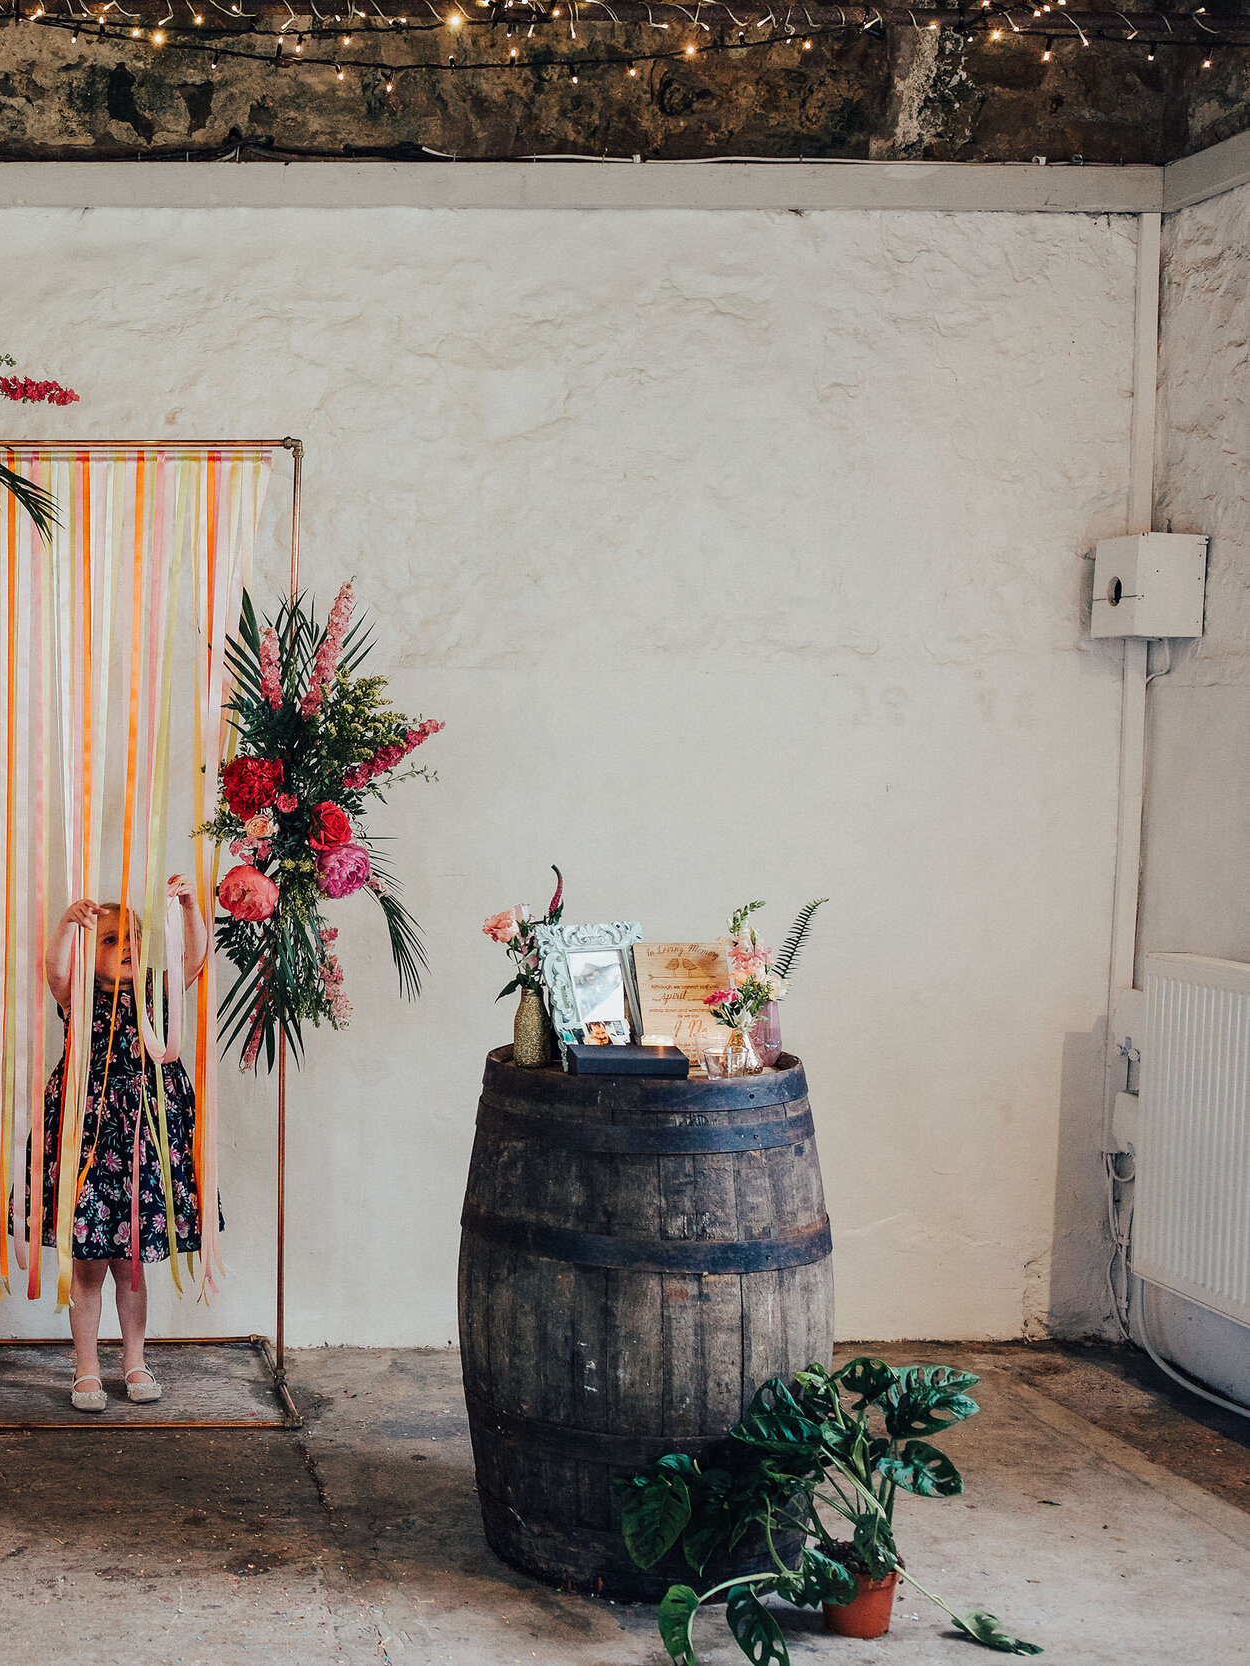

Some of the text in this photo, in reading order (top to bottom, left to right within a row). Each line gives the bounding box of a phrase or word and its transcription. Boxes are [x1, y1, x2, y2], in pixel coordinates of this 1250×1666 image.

[646, 944, 719, 962] In Loving Memory
[661, 989, 688, 1005] spirit
